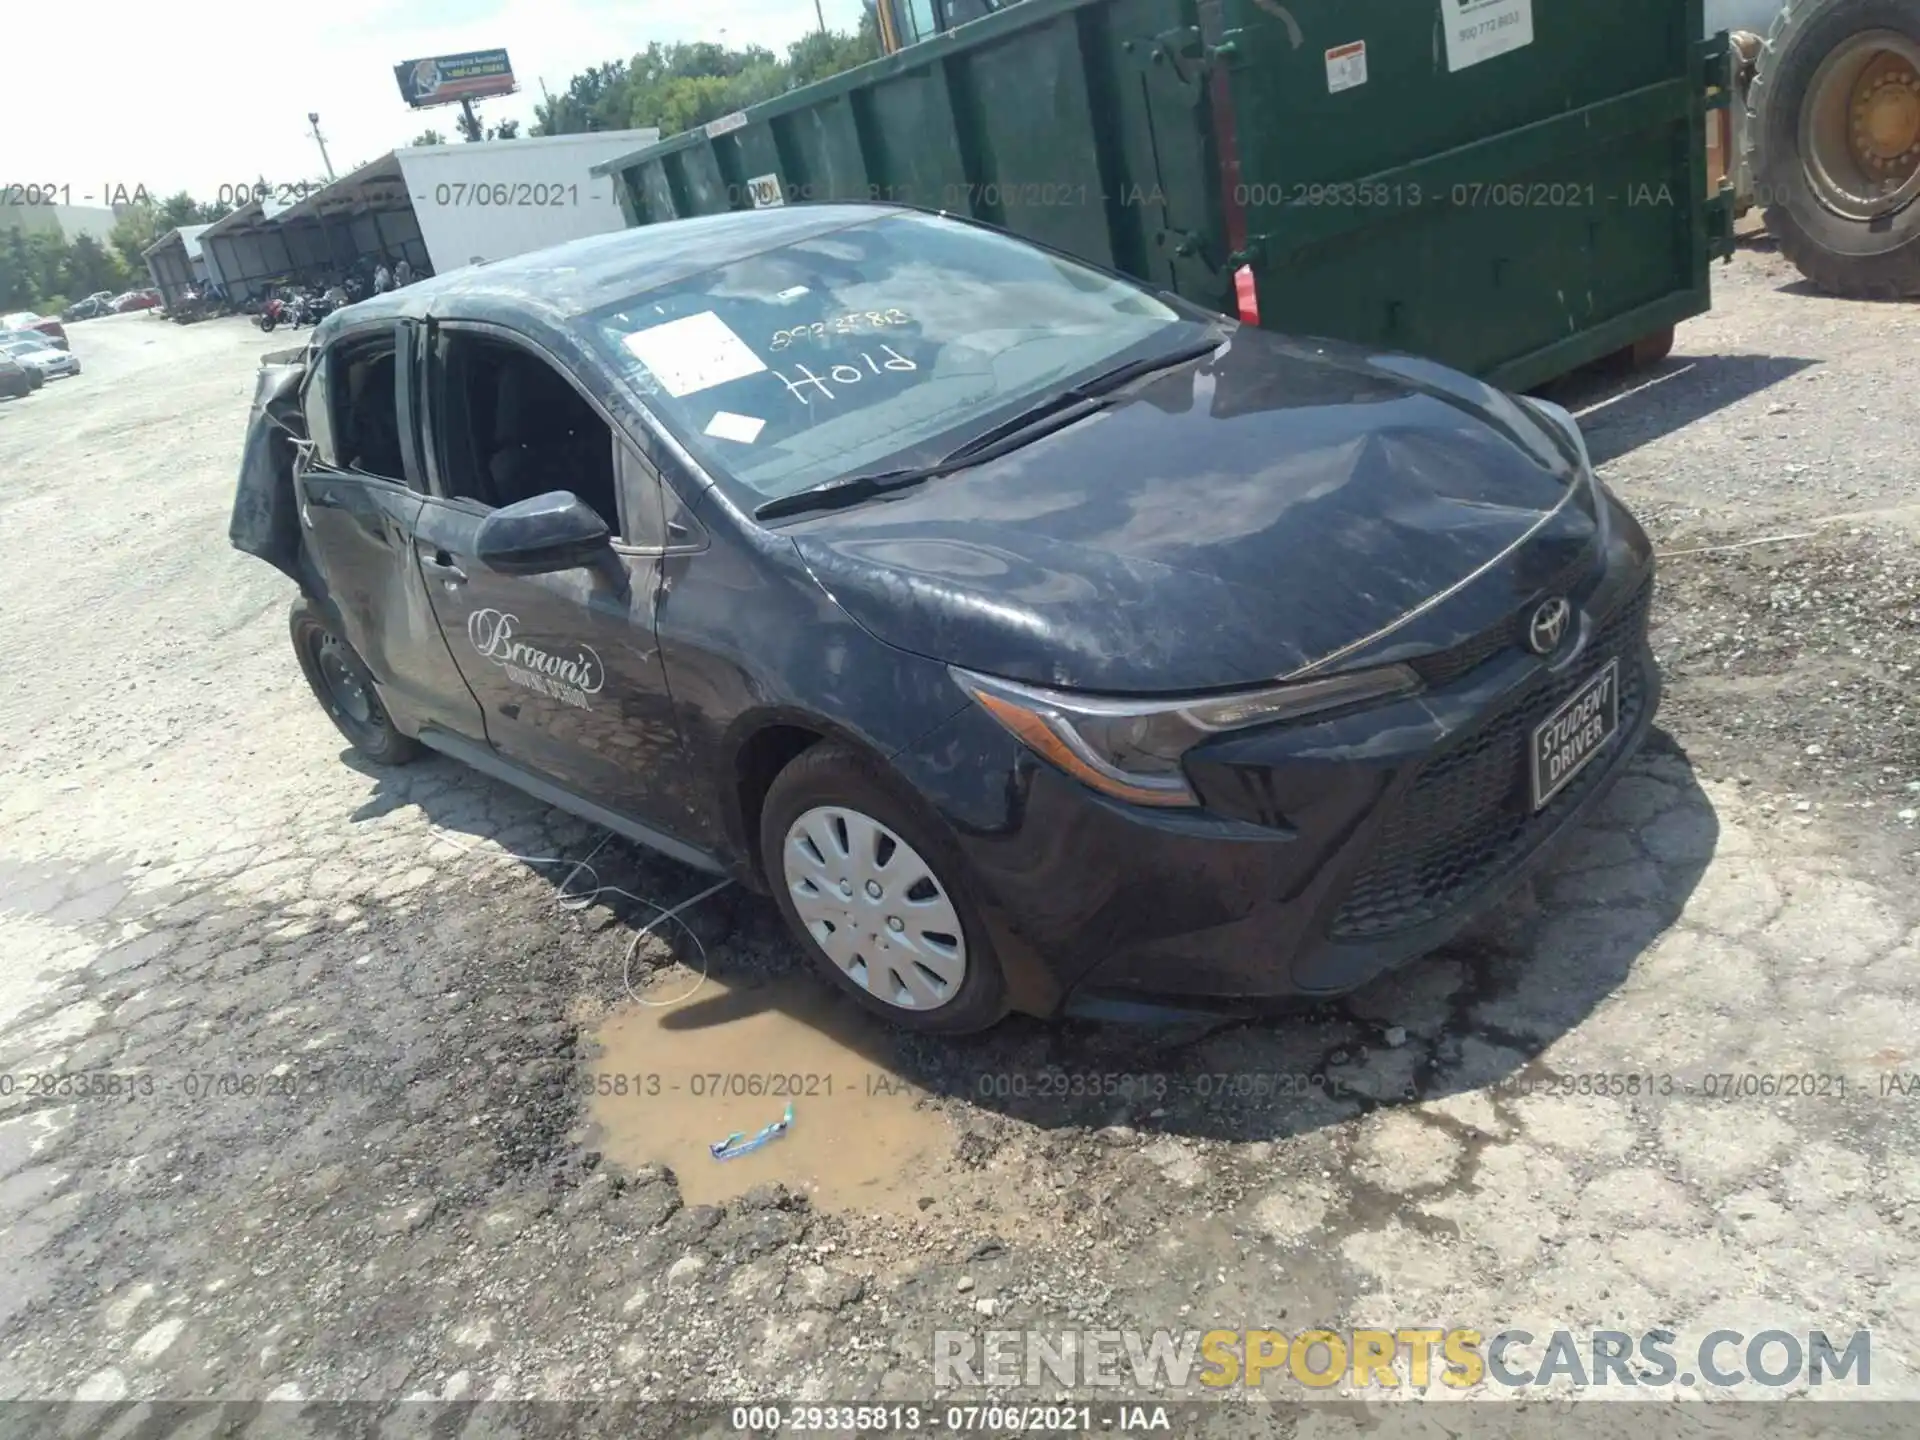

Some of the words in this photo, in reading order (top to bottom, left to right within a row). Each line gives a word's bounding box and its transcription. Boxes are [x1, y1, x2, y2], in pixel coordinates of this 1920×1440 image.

[772, 344, 917, 404] Hold
[468, 608, 605, 693] Brown's
[1541, 675, 1612, 761] STUDENT
[1549, 713, 1604, 781] DRIVER
